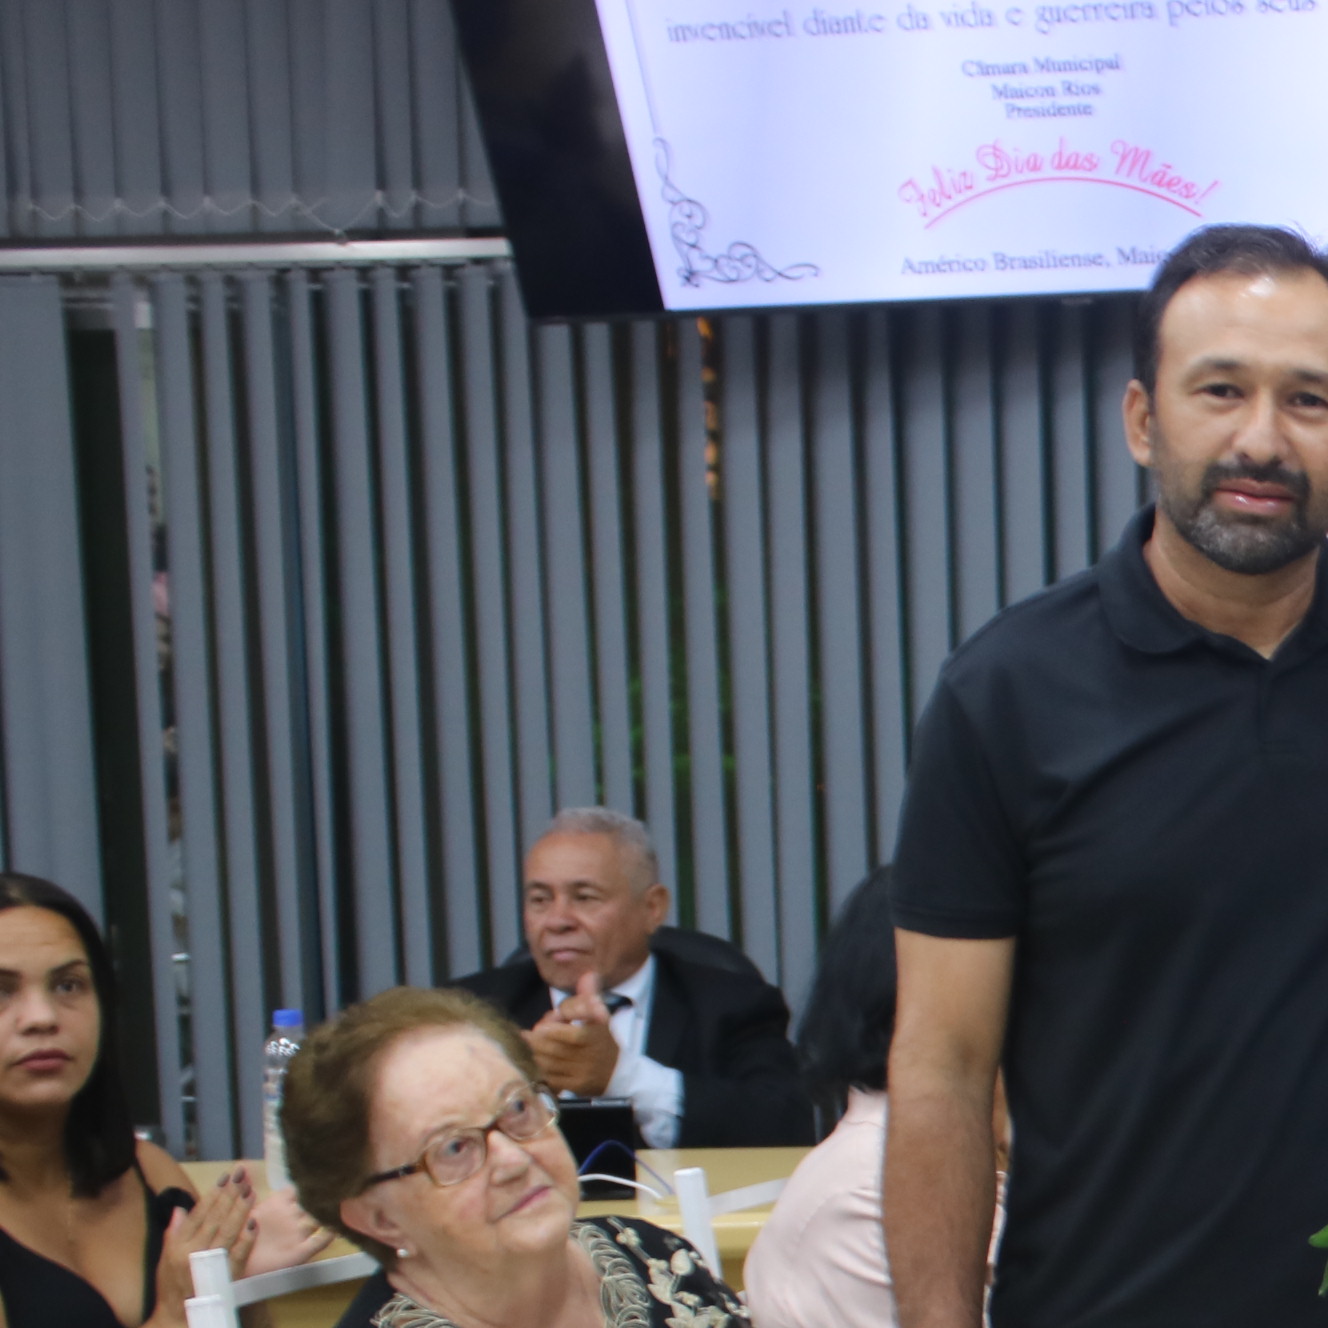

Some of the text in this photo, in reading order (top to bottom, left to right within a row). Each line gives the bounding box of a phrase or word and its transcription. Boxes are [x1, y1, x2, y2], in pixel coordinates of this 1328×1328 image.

[803, 8, 886, 36] diante
[897, 4, 929, 31] da
[940, 0, 995, 28] vida
[1005, 7, 1025, 26] e
[1035, 0, 1155, 34] guerreira
[961, 53, 1121, 78] Câmara Municipal
[991, 79, 1102, 101] Maicon Rios
[1004, 102, 1093, 119] Presidente
[898, 136, 1221, 218] Feliz Dia das Mães!
[901, 252, 986, 275] Américo
[992, 247, 1111, 271] Brasiliense,
